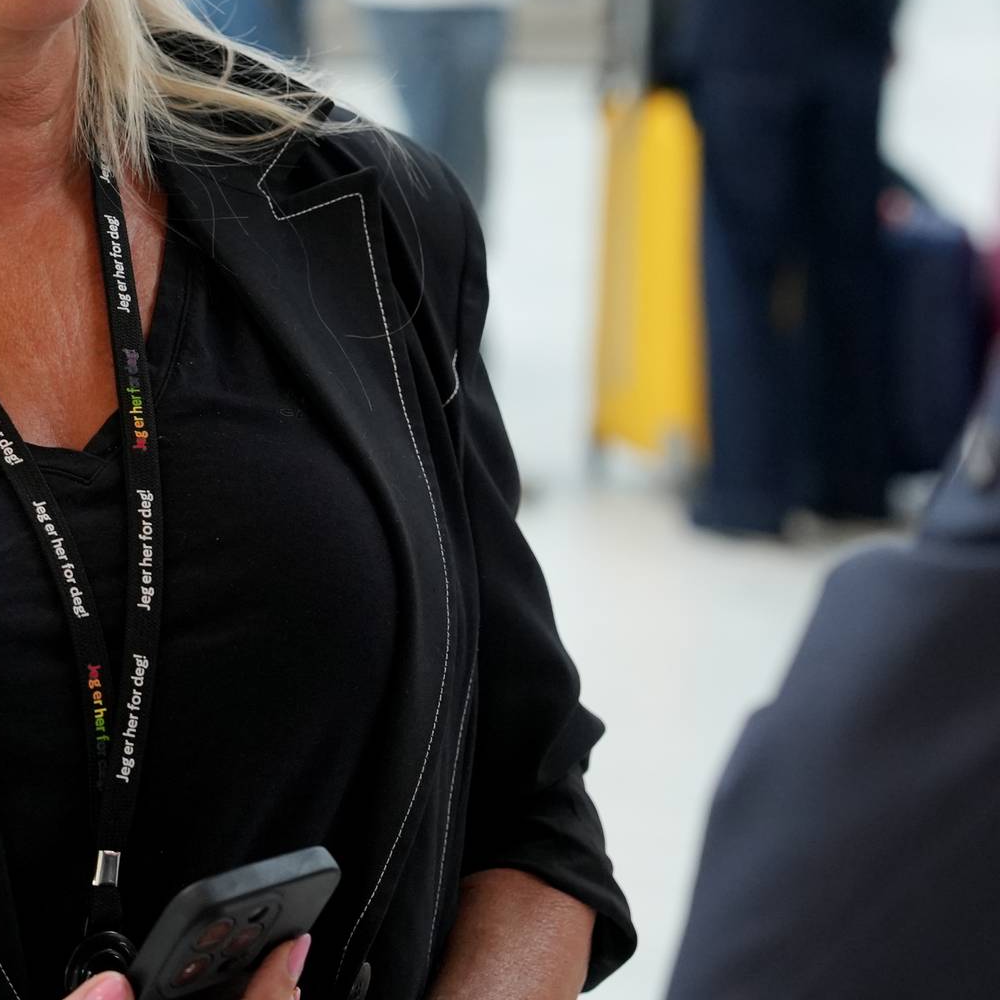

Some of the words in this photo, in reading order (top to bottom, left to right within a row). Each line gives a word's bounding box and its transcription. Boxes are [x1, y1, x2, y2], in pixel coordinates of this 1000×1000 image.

[104, 214, 120, 240] deg!
[109, 244, 123, 259] for
[113, 262, 126, 279] her
[117, 278, 128, 292] er
[117, 293, 132, 313] Jeg
[129, 395, 143, 414] her
[134, 416, 145, 429] er
[32, 501, 52, 523] Jeg
[136, 489, 154, 518] deg!
[44, 523, 58, 536] er
[138, 520, 153, 541] for
[50, 537, 69, 561] her
[138, 543, 153, 567] her
[61, 563, 77, 584] for
[141, 569, 153, 584] er
[69, 586, 90, 619] deg!
[136, 586, 155, 611] Jeg
[130, 654, 149, 687] deg!
[92, 690, 103, 706] er
[126, 689, 142, 711] for
[94, 707, 107, 732] her
[122, 713, 139, 738] her
[123, 739, 134, 755] er
[115, 757, 135, 783] Jeg
